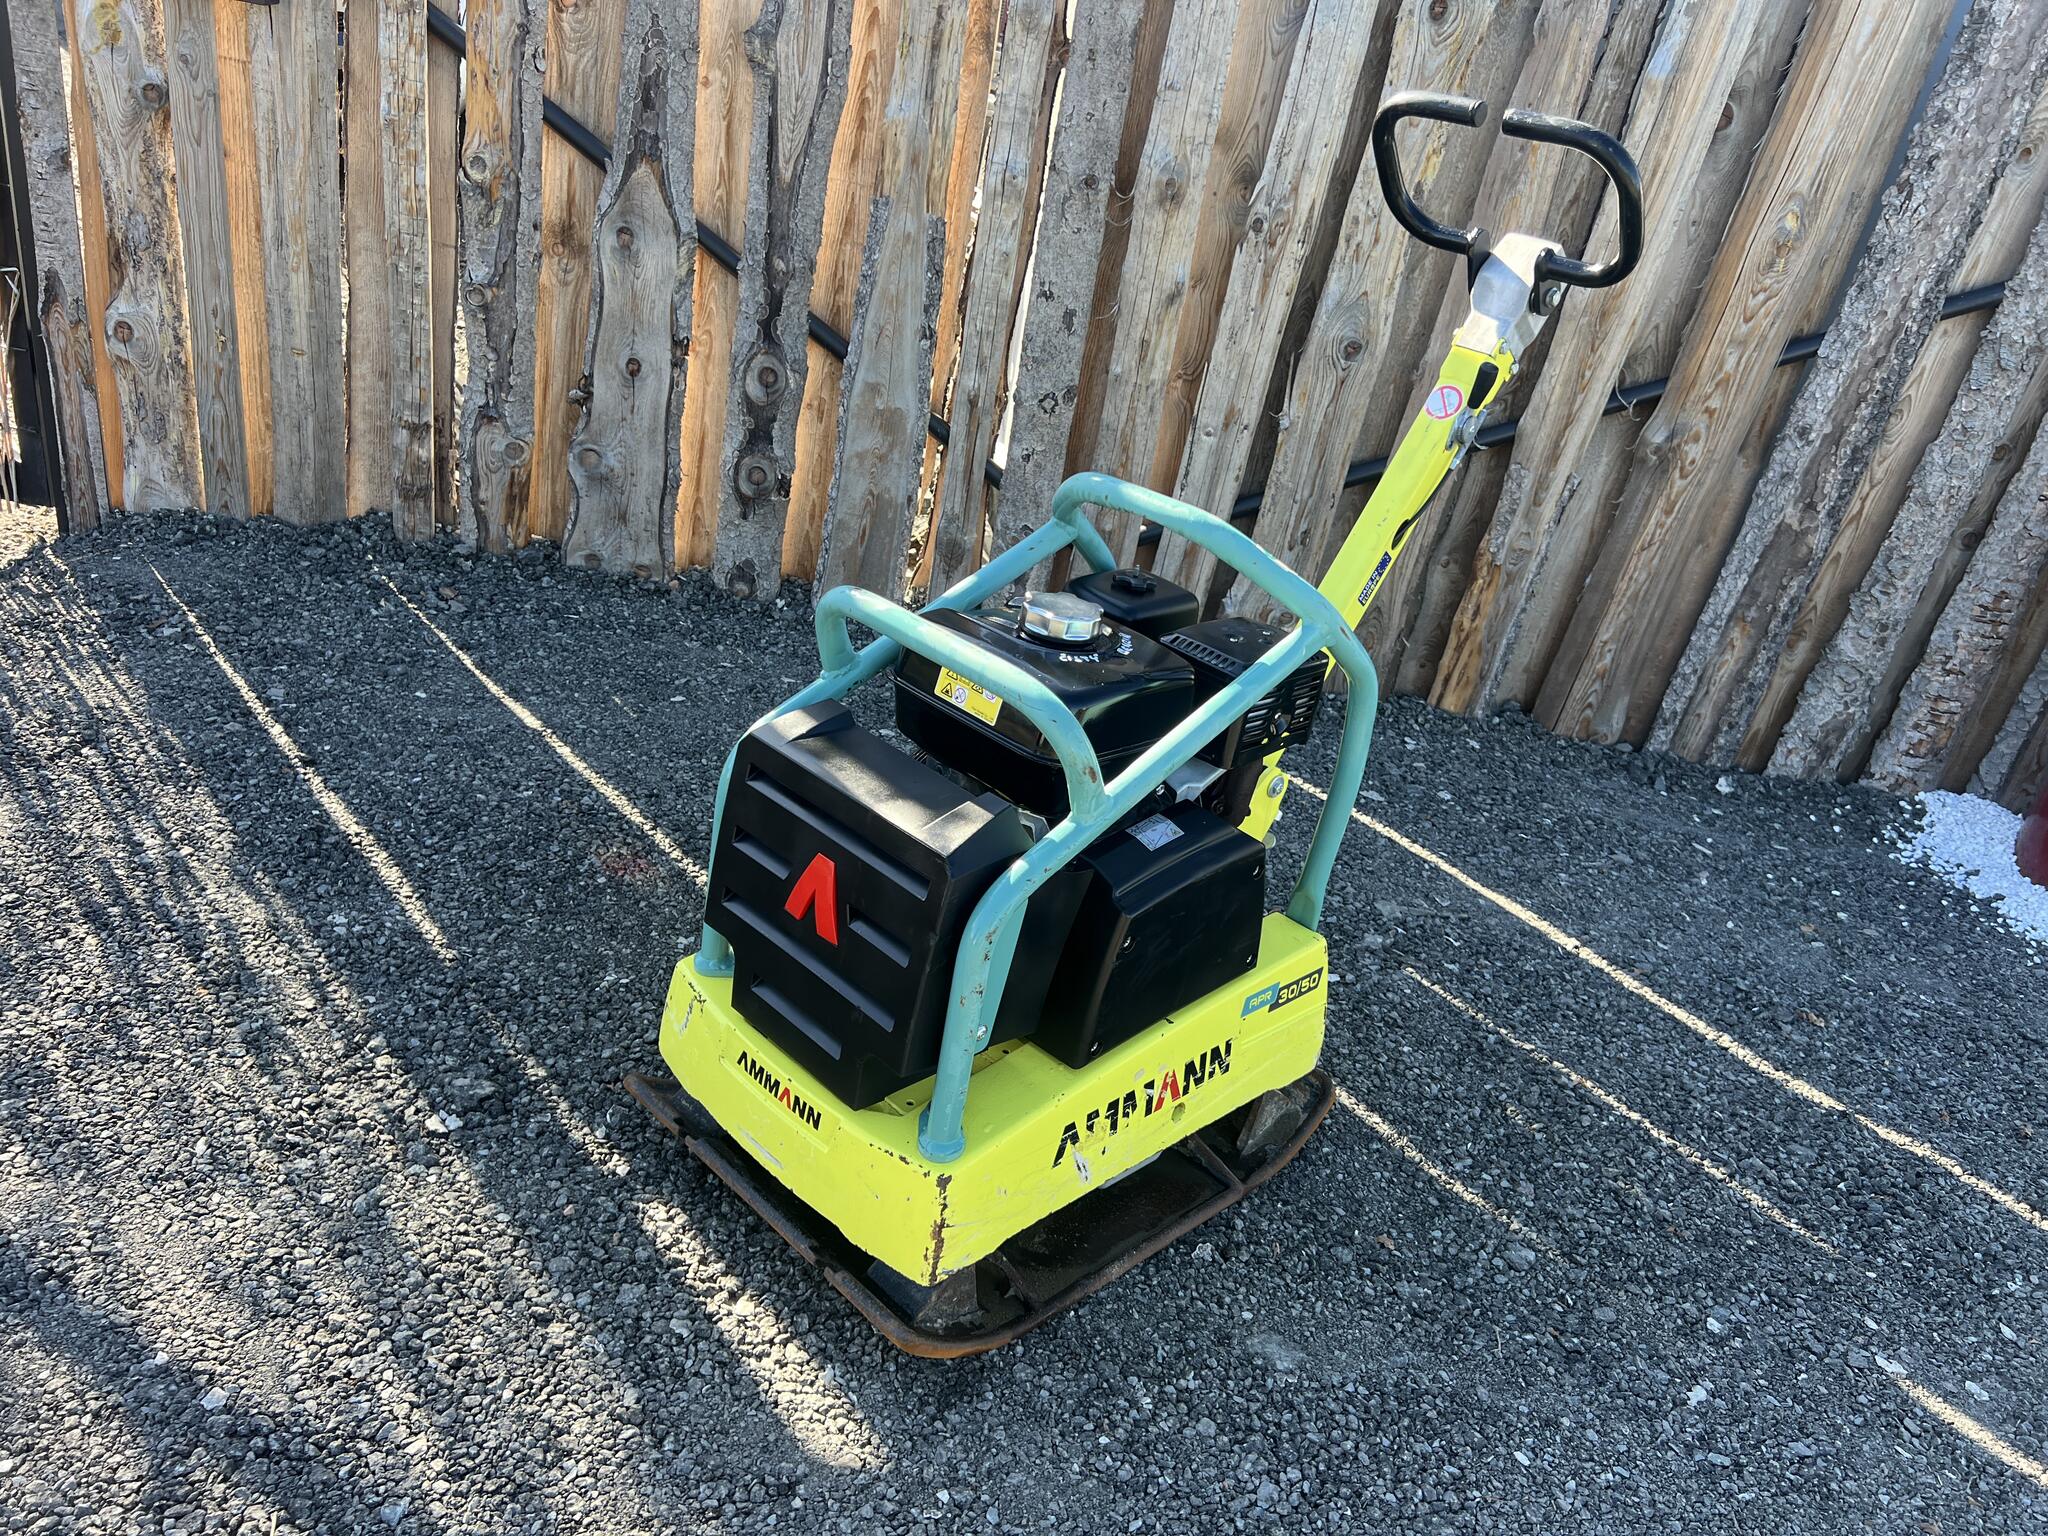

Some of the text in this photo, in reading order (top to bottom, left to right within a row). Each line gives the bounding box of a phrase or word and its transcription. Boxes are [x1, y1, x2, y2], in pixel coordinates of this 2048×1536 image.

[1249, 973, 1319, 1009] APR 30/50
[736, 1050, 822, 1131] AMMANN
